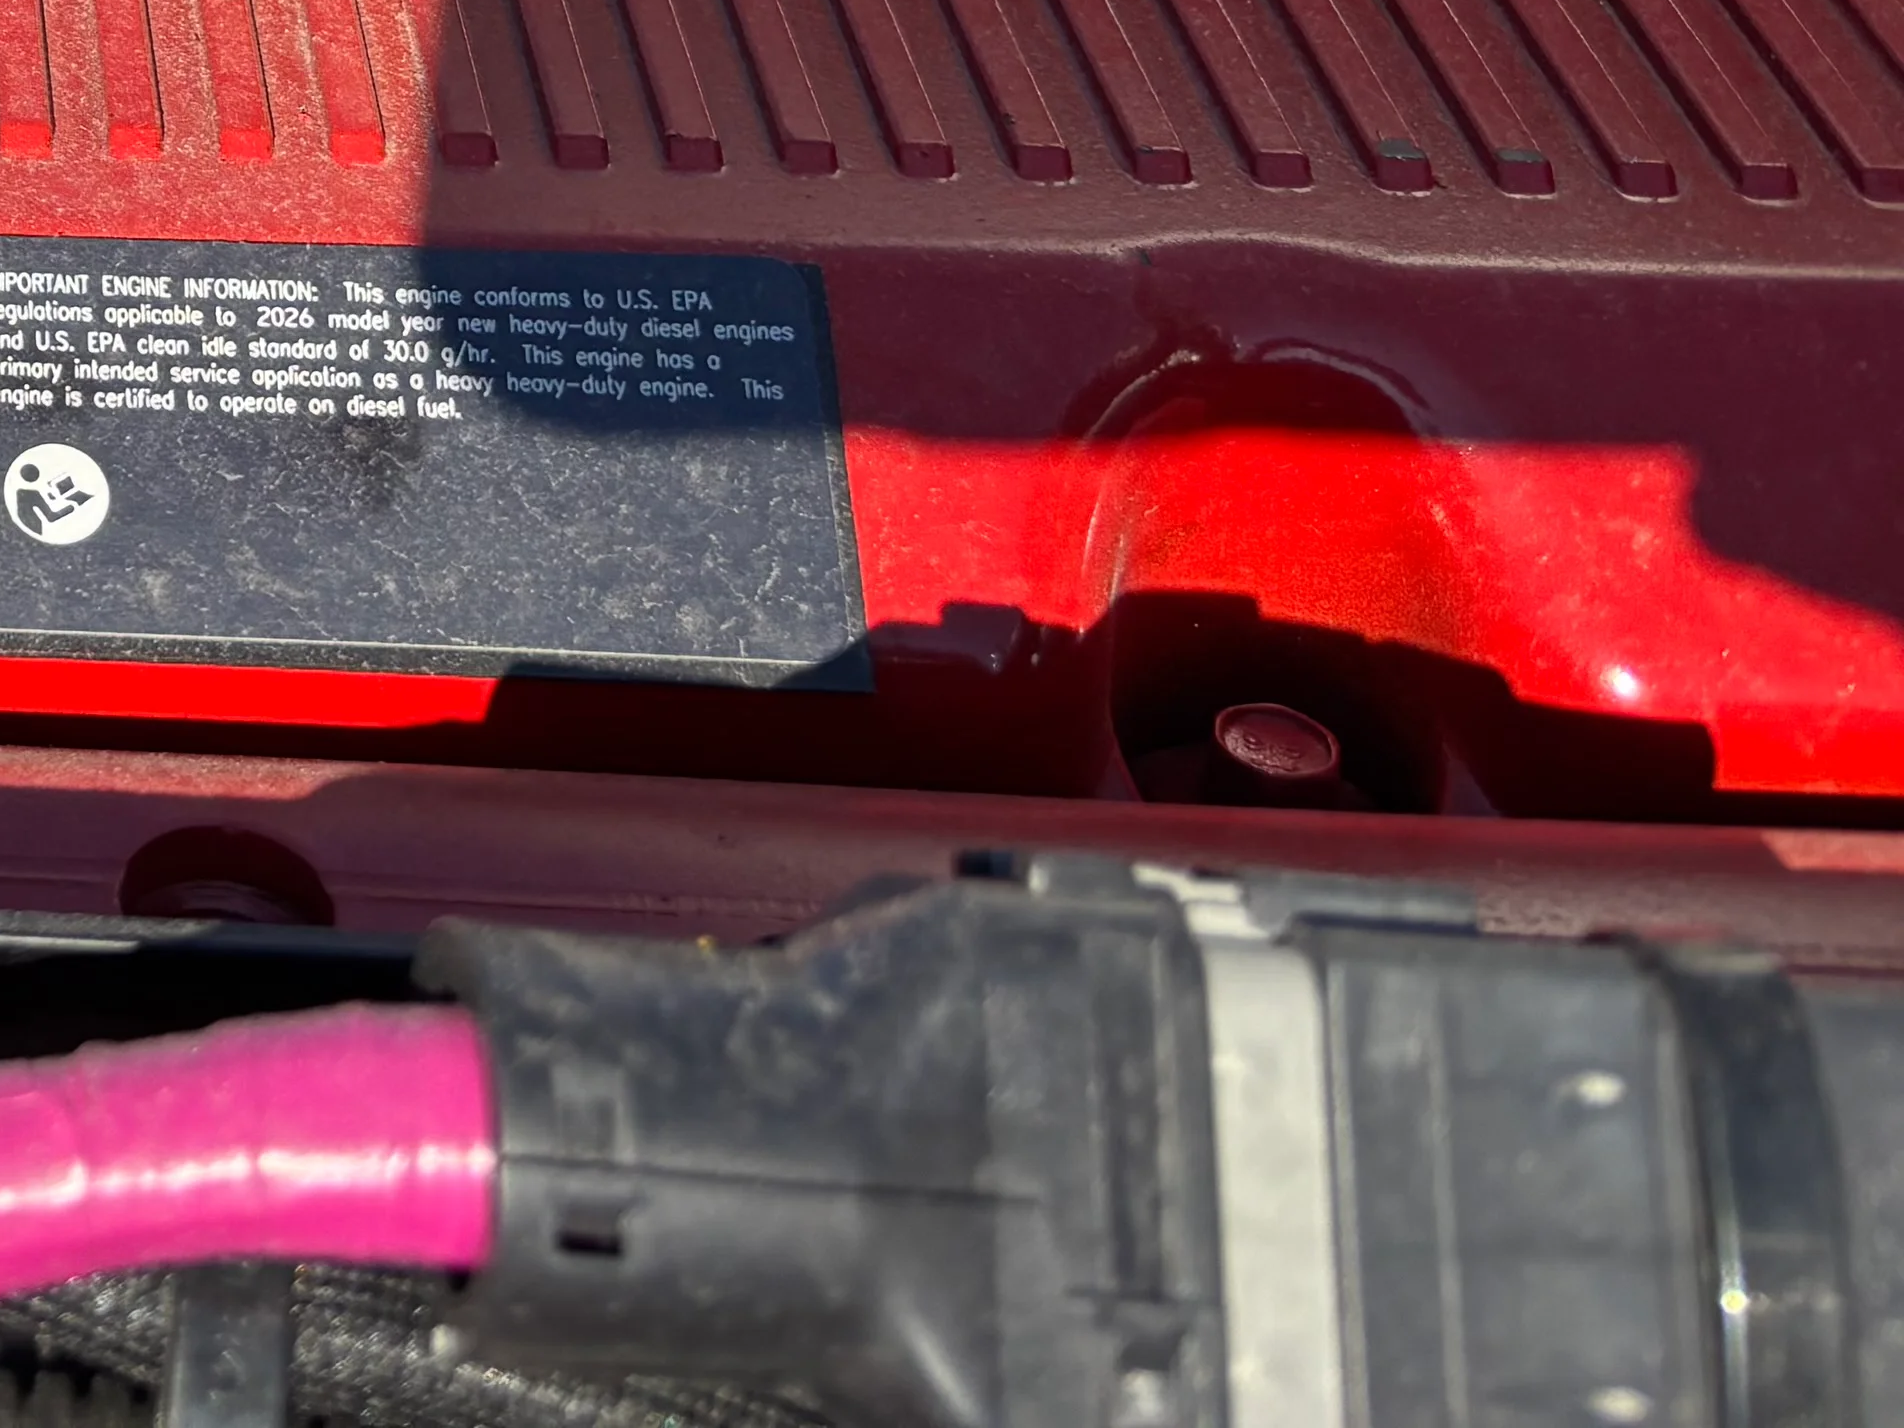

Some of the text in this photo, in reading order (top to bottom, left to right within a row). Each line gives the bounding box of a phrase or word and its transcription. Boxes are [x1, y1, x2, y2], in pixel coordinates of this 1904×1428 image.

[101, 274, 172, 298] ENGINE
[183, 277, 319, 302] INFORMATION:
[343, 281, 385, 304] This
[395, 285, 462, 310] engine
[474, 286, 572, 308] conforms
[583, 289, 605, 309] to
[617, 289, 659, 310] U.S.
[671, 290, 713, 311] EPA
[104, 304, 204, 328] applicable
[215, 306, 236, 327] to
[256, 305, 315, 328] 2026
[328, 309, 390, 331] model
[401, 314, 444, 336] year
[458, 317, 496, 333] new
[509, 313, 628, 342] heavy-duty
[641, 317, 700, 338] diesel
[713, 320, 795, 346] engines
[35, 330, 75, 352] U.S.
[87, 331, 127, 353] EPA
[137, 334, 190, 355] clean
[202, 335, 237, 357] idle
[248, 337, 337, 360] standard
[349, 339, 370, 361] of
[441, 340, 495, 368] g/hr.
[522, 344, 563, 365] This
[576, 347, 643, 372] engine
[656, 348, 695, 370] has
[707, 354, 721, 370] a
[73, 358, 158, 382] intended
[170, 362, 240, 385] service
[252, 364, 361, 390] application
[373, 372, 399, 389] as
[409, 373, 424, 390] a
[435, 370, 494, 397] heavy
[507, 371, 626, 400] heavy-duty
[639, 376, 714, 403] engine.
[741, 378, 784, 400] This
[65, 386, 82, 407] is
[94, 388, 175, 410] certified
[187, 389, 209, 411] to
[220, 392, 297, 417] operate
[308, 397, 336, 415] on
[347, 394, 405, 417] diesel
[417, 395, 463, 420] fuel.
